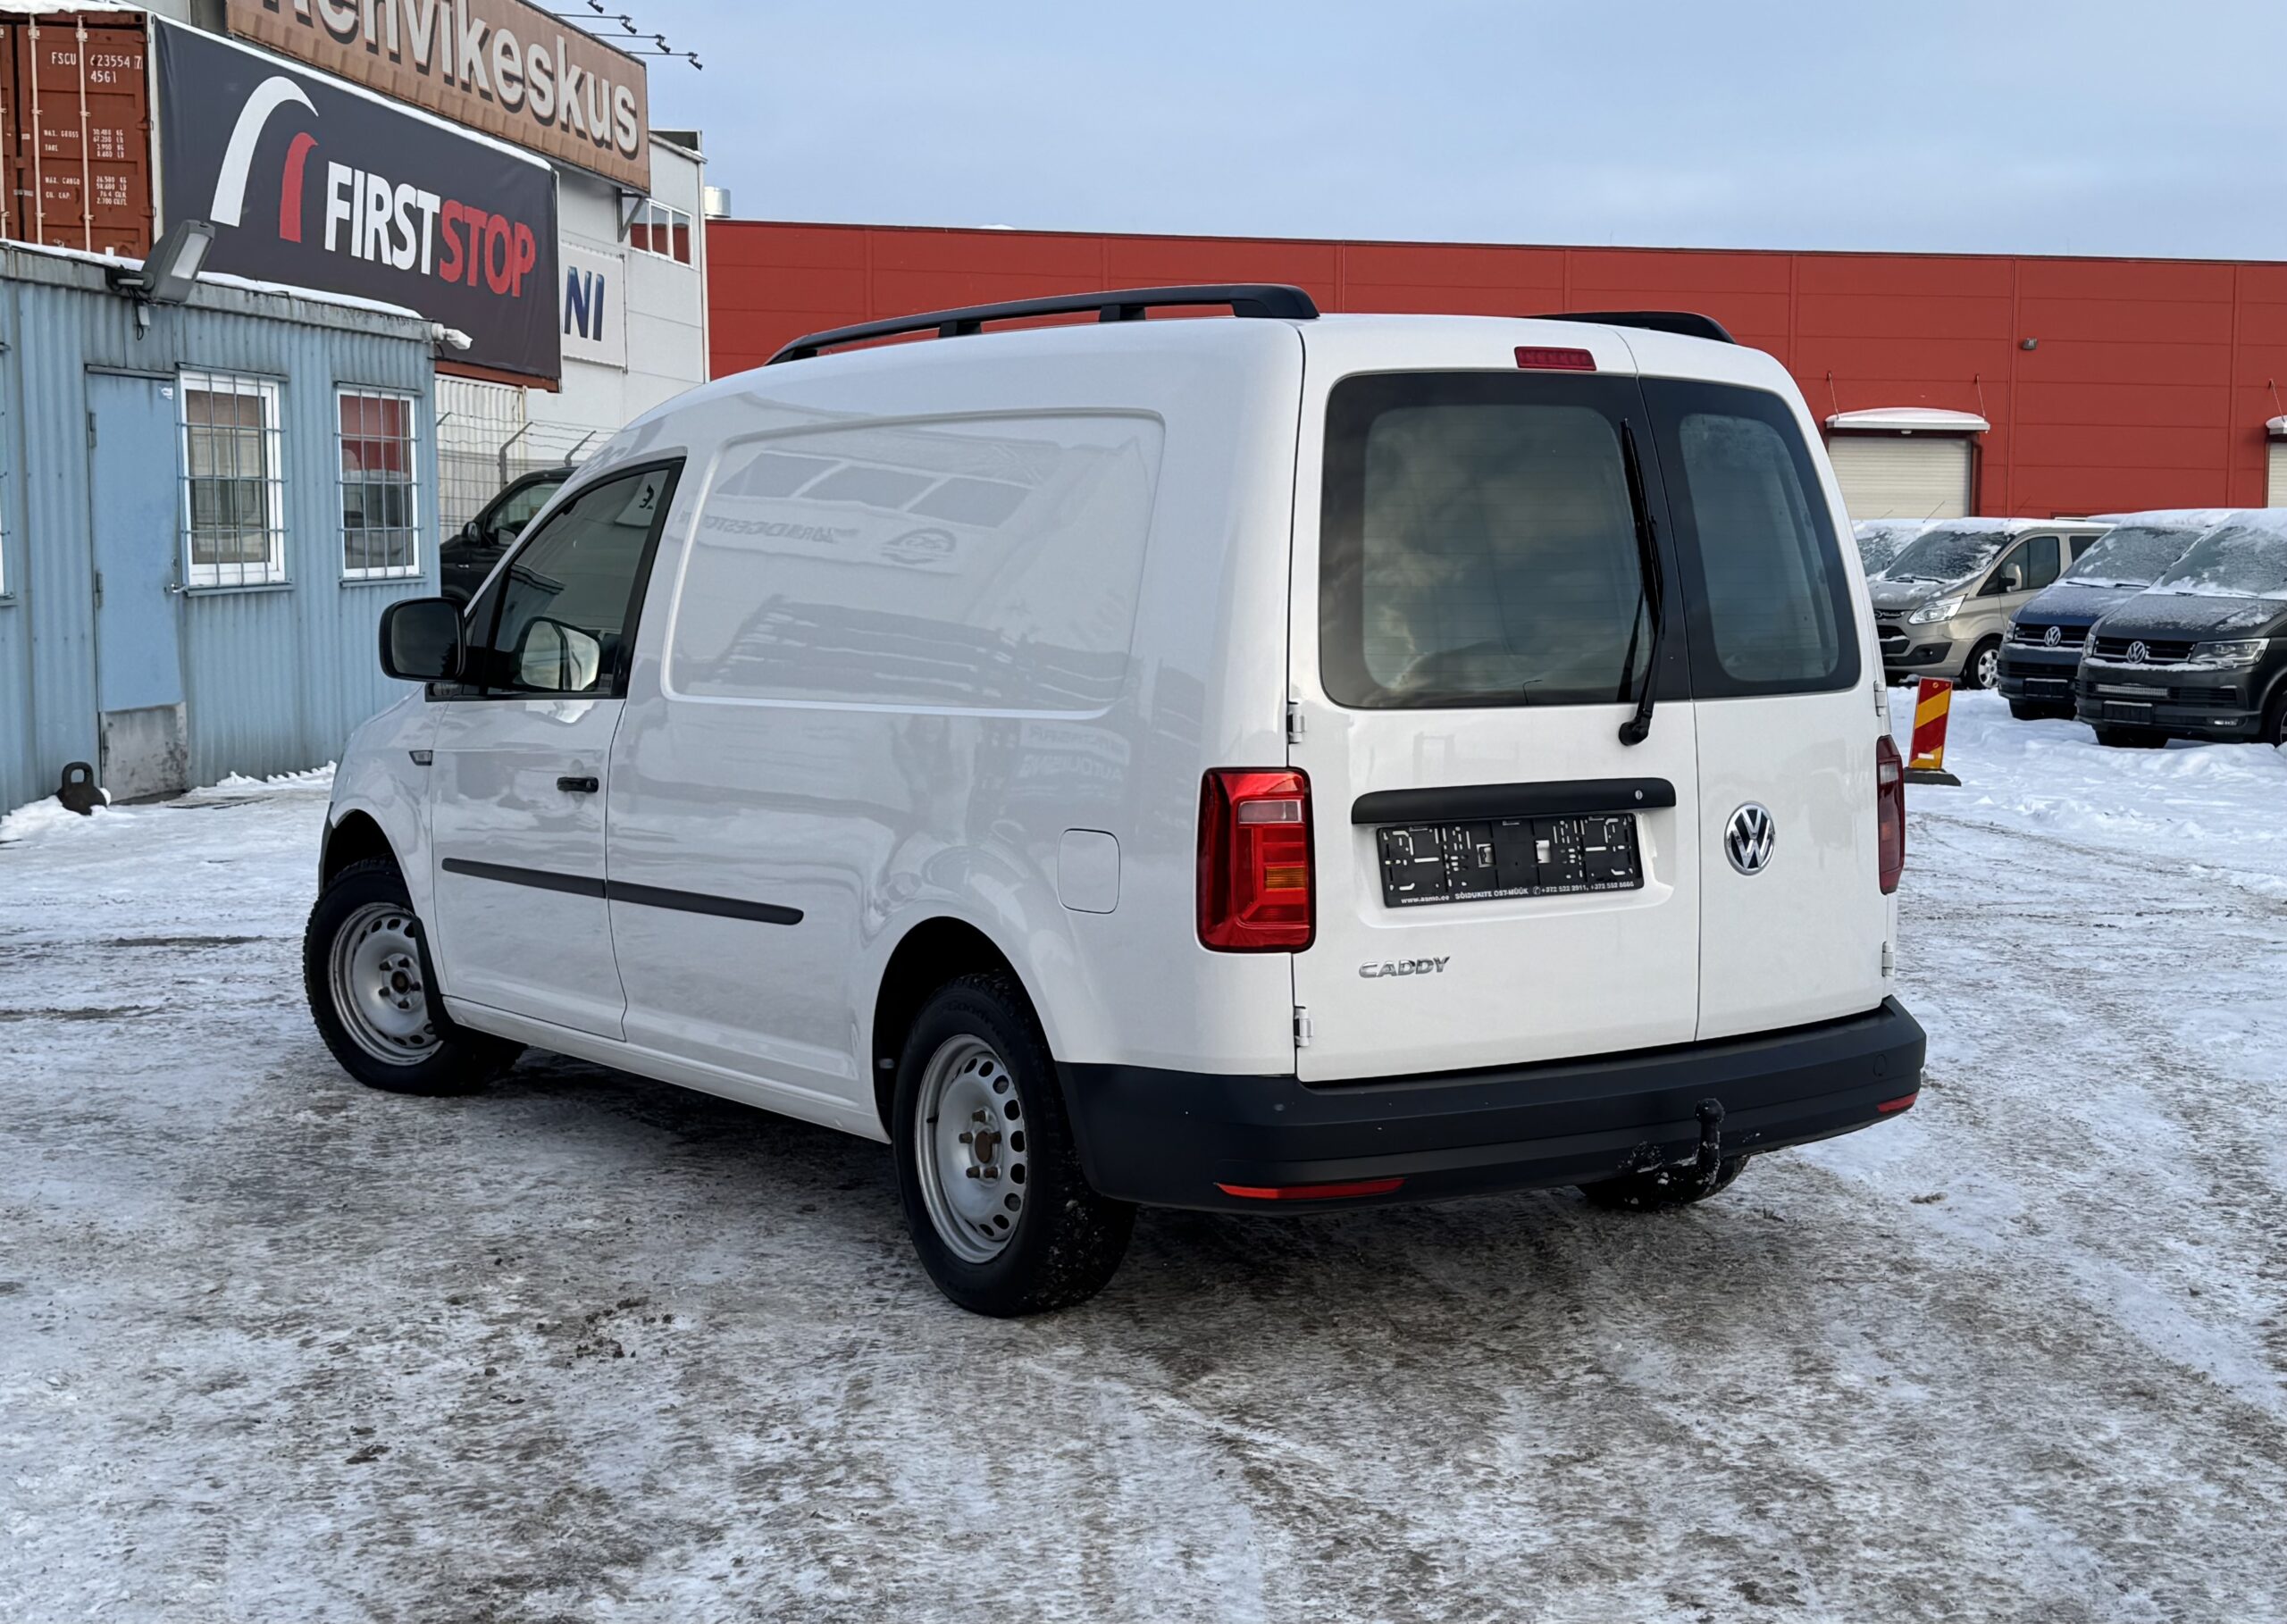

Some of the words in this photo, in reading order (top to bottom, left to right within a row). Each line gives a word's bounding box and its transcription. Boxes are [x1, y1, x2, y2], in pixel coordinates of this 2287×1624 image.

[51, 52, 77, 65] FSCU
[90, 71, 116, 83] 45G1
[294, 0, 639, 153] vikeskus
[561, 265, 605, 342] NI
[1358, 956, 1451, 978] CADDY
